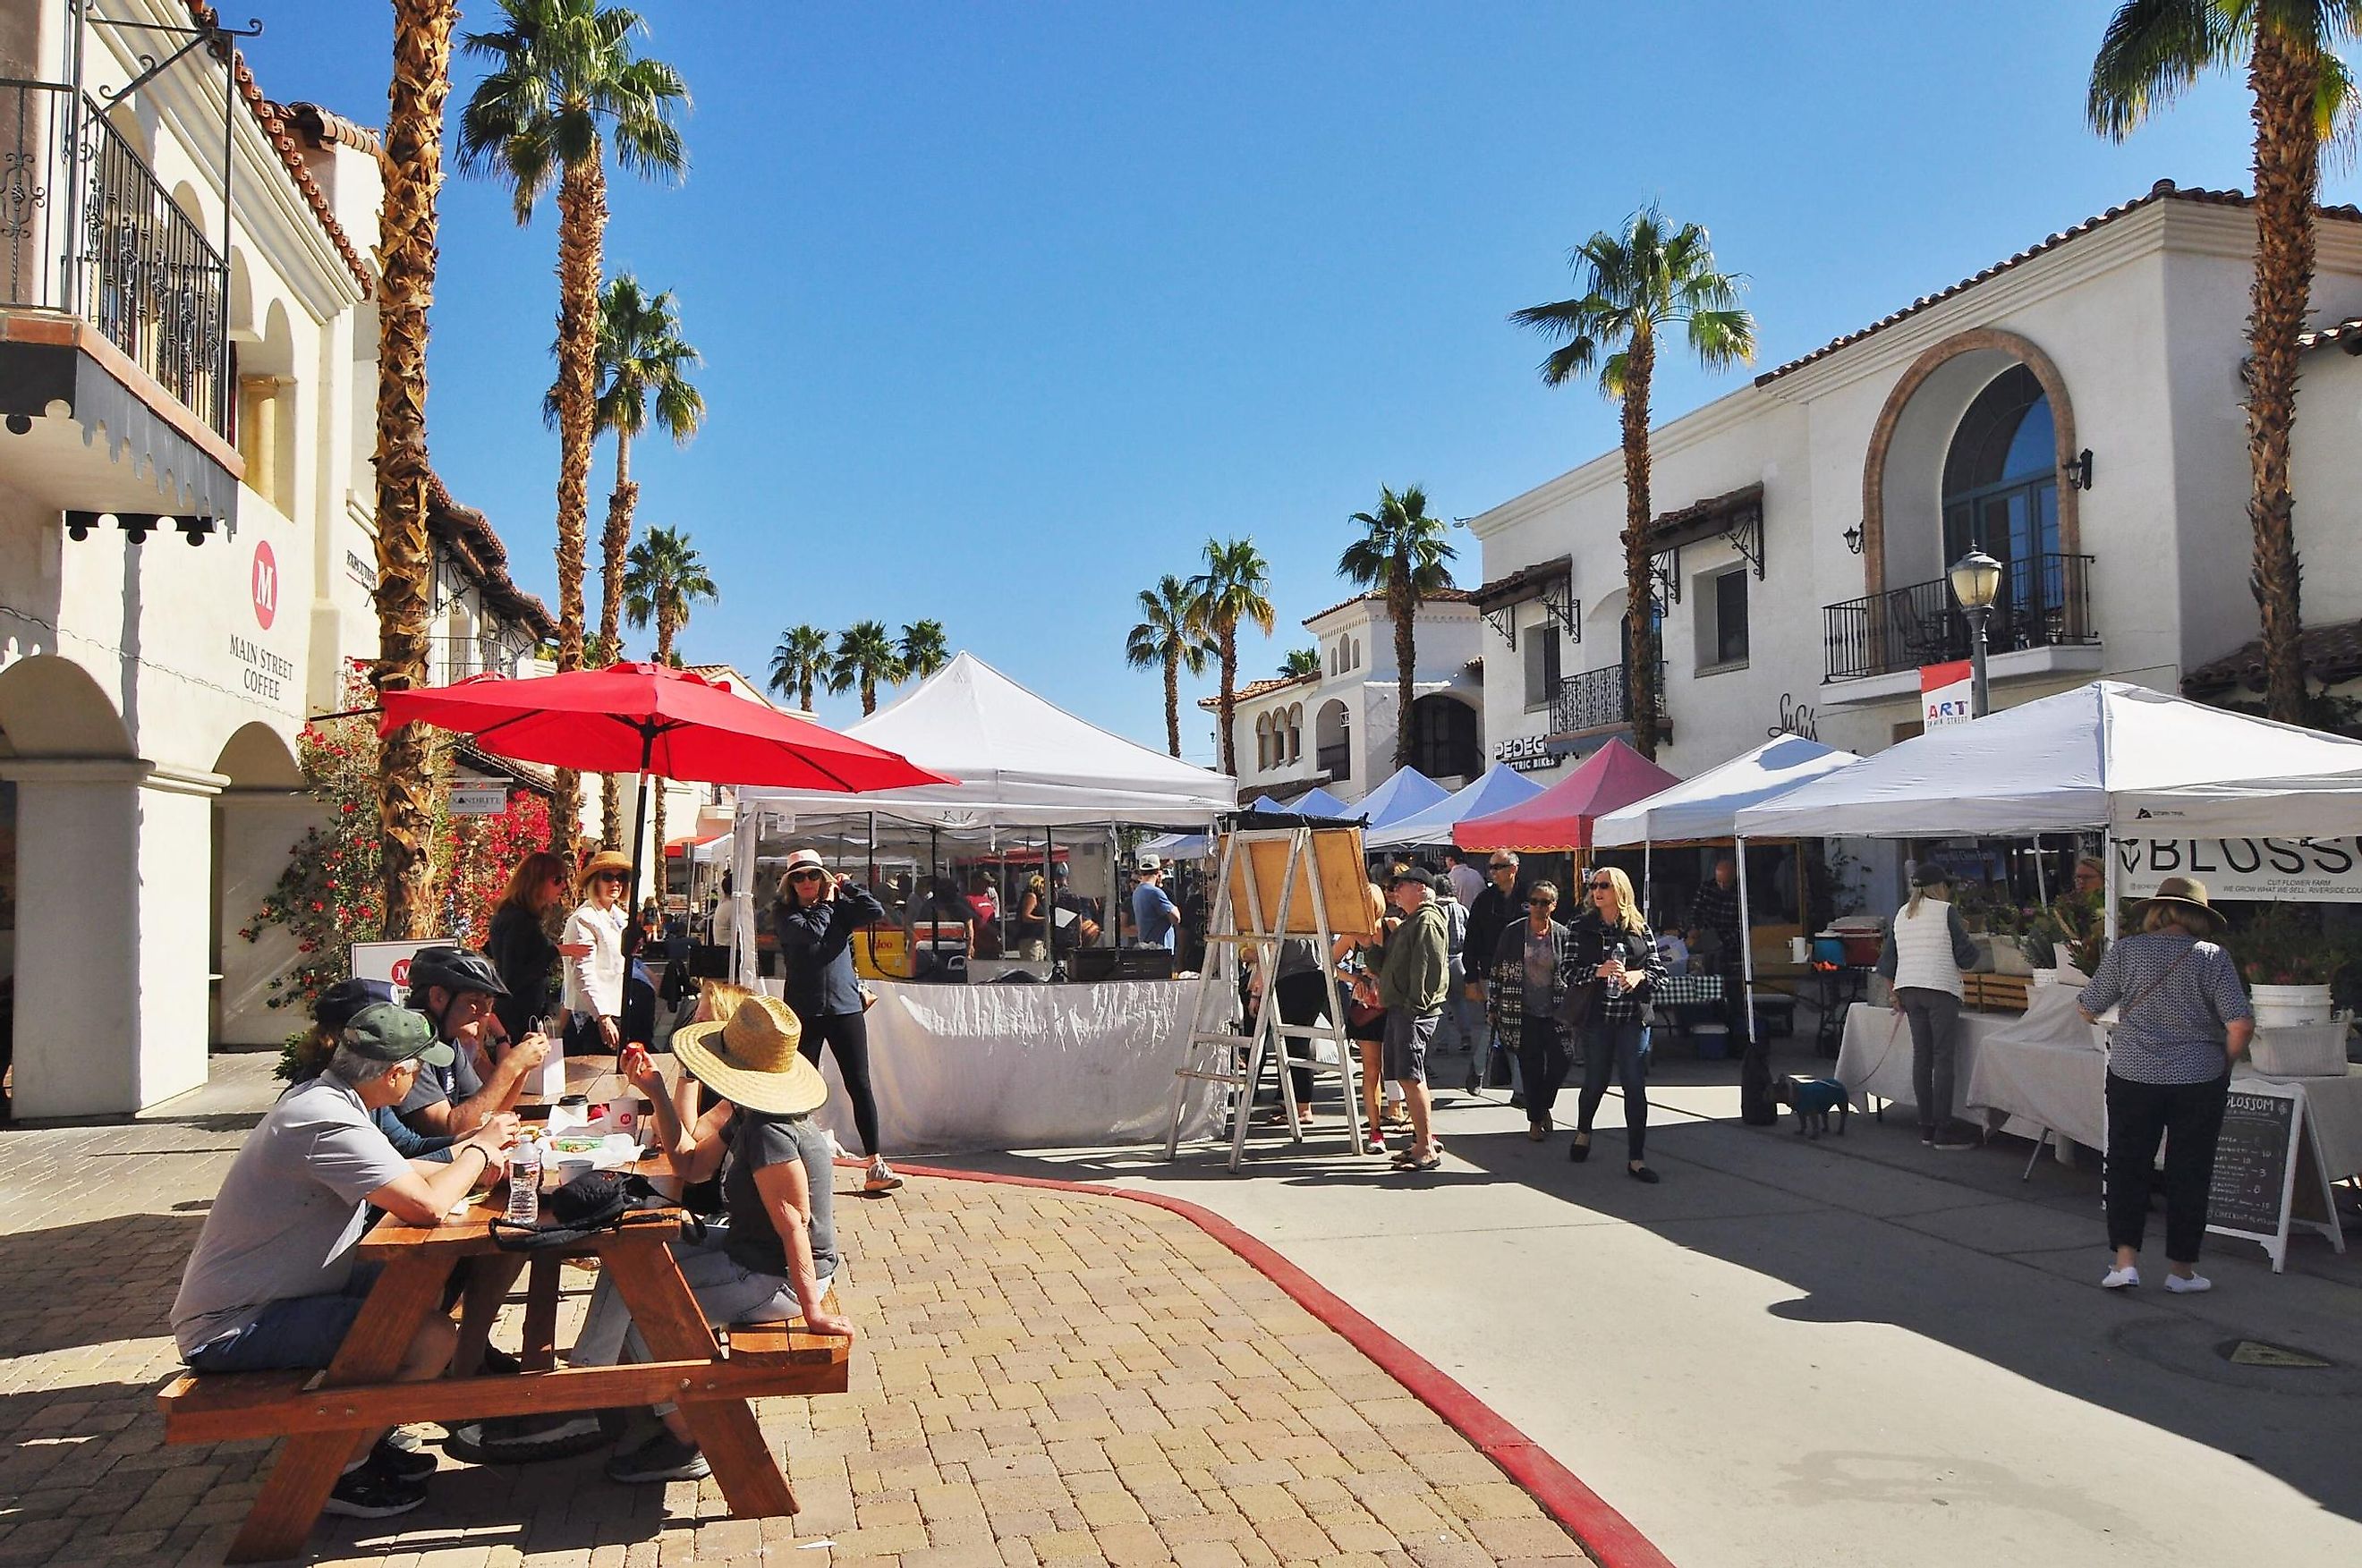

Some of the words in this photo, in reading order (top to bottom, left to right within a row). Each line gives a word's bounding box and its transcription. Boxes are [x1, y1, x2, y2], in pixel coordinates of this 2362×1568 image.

[256, 559, 274, 612] M
[230, 634, 258, 665] MAIN
[260, 648, 293, 681] STREET
[243, 668, 280, 700] COFFEE
[1927, 700, 1968, 719] ART
[1493, 734, 1548, 759] PEDEG
[1533, 757, 1555, 767] BIKES
[2149, 838, 2362, 874] BLOSS
